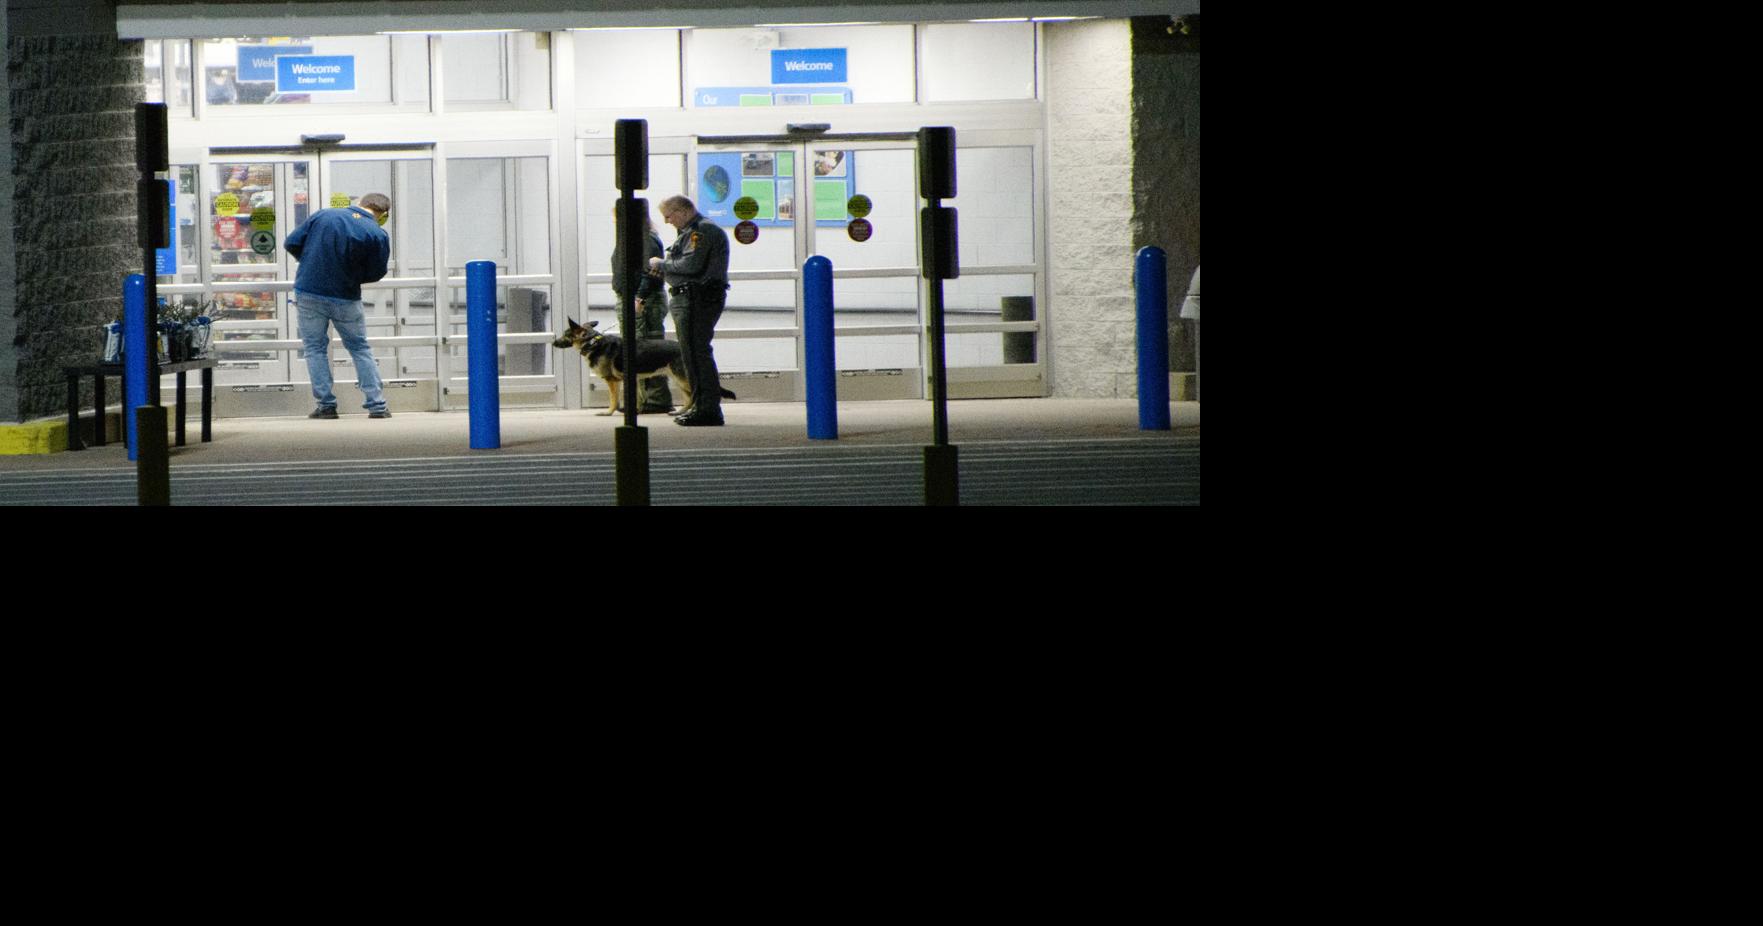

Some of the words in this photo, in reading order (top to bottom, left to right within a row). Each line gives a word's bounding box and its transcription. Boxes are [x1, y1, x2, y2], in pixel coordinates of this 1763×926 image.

[252, 57, 275, 68] Welc
[784, 60, 833, 71] Welcome
[291, 63, 341, 74] Welcome
[297, 76, 317, 84] Enter
[318, 76, 336, 84] here
[702, 94, 718, 105] Our
